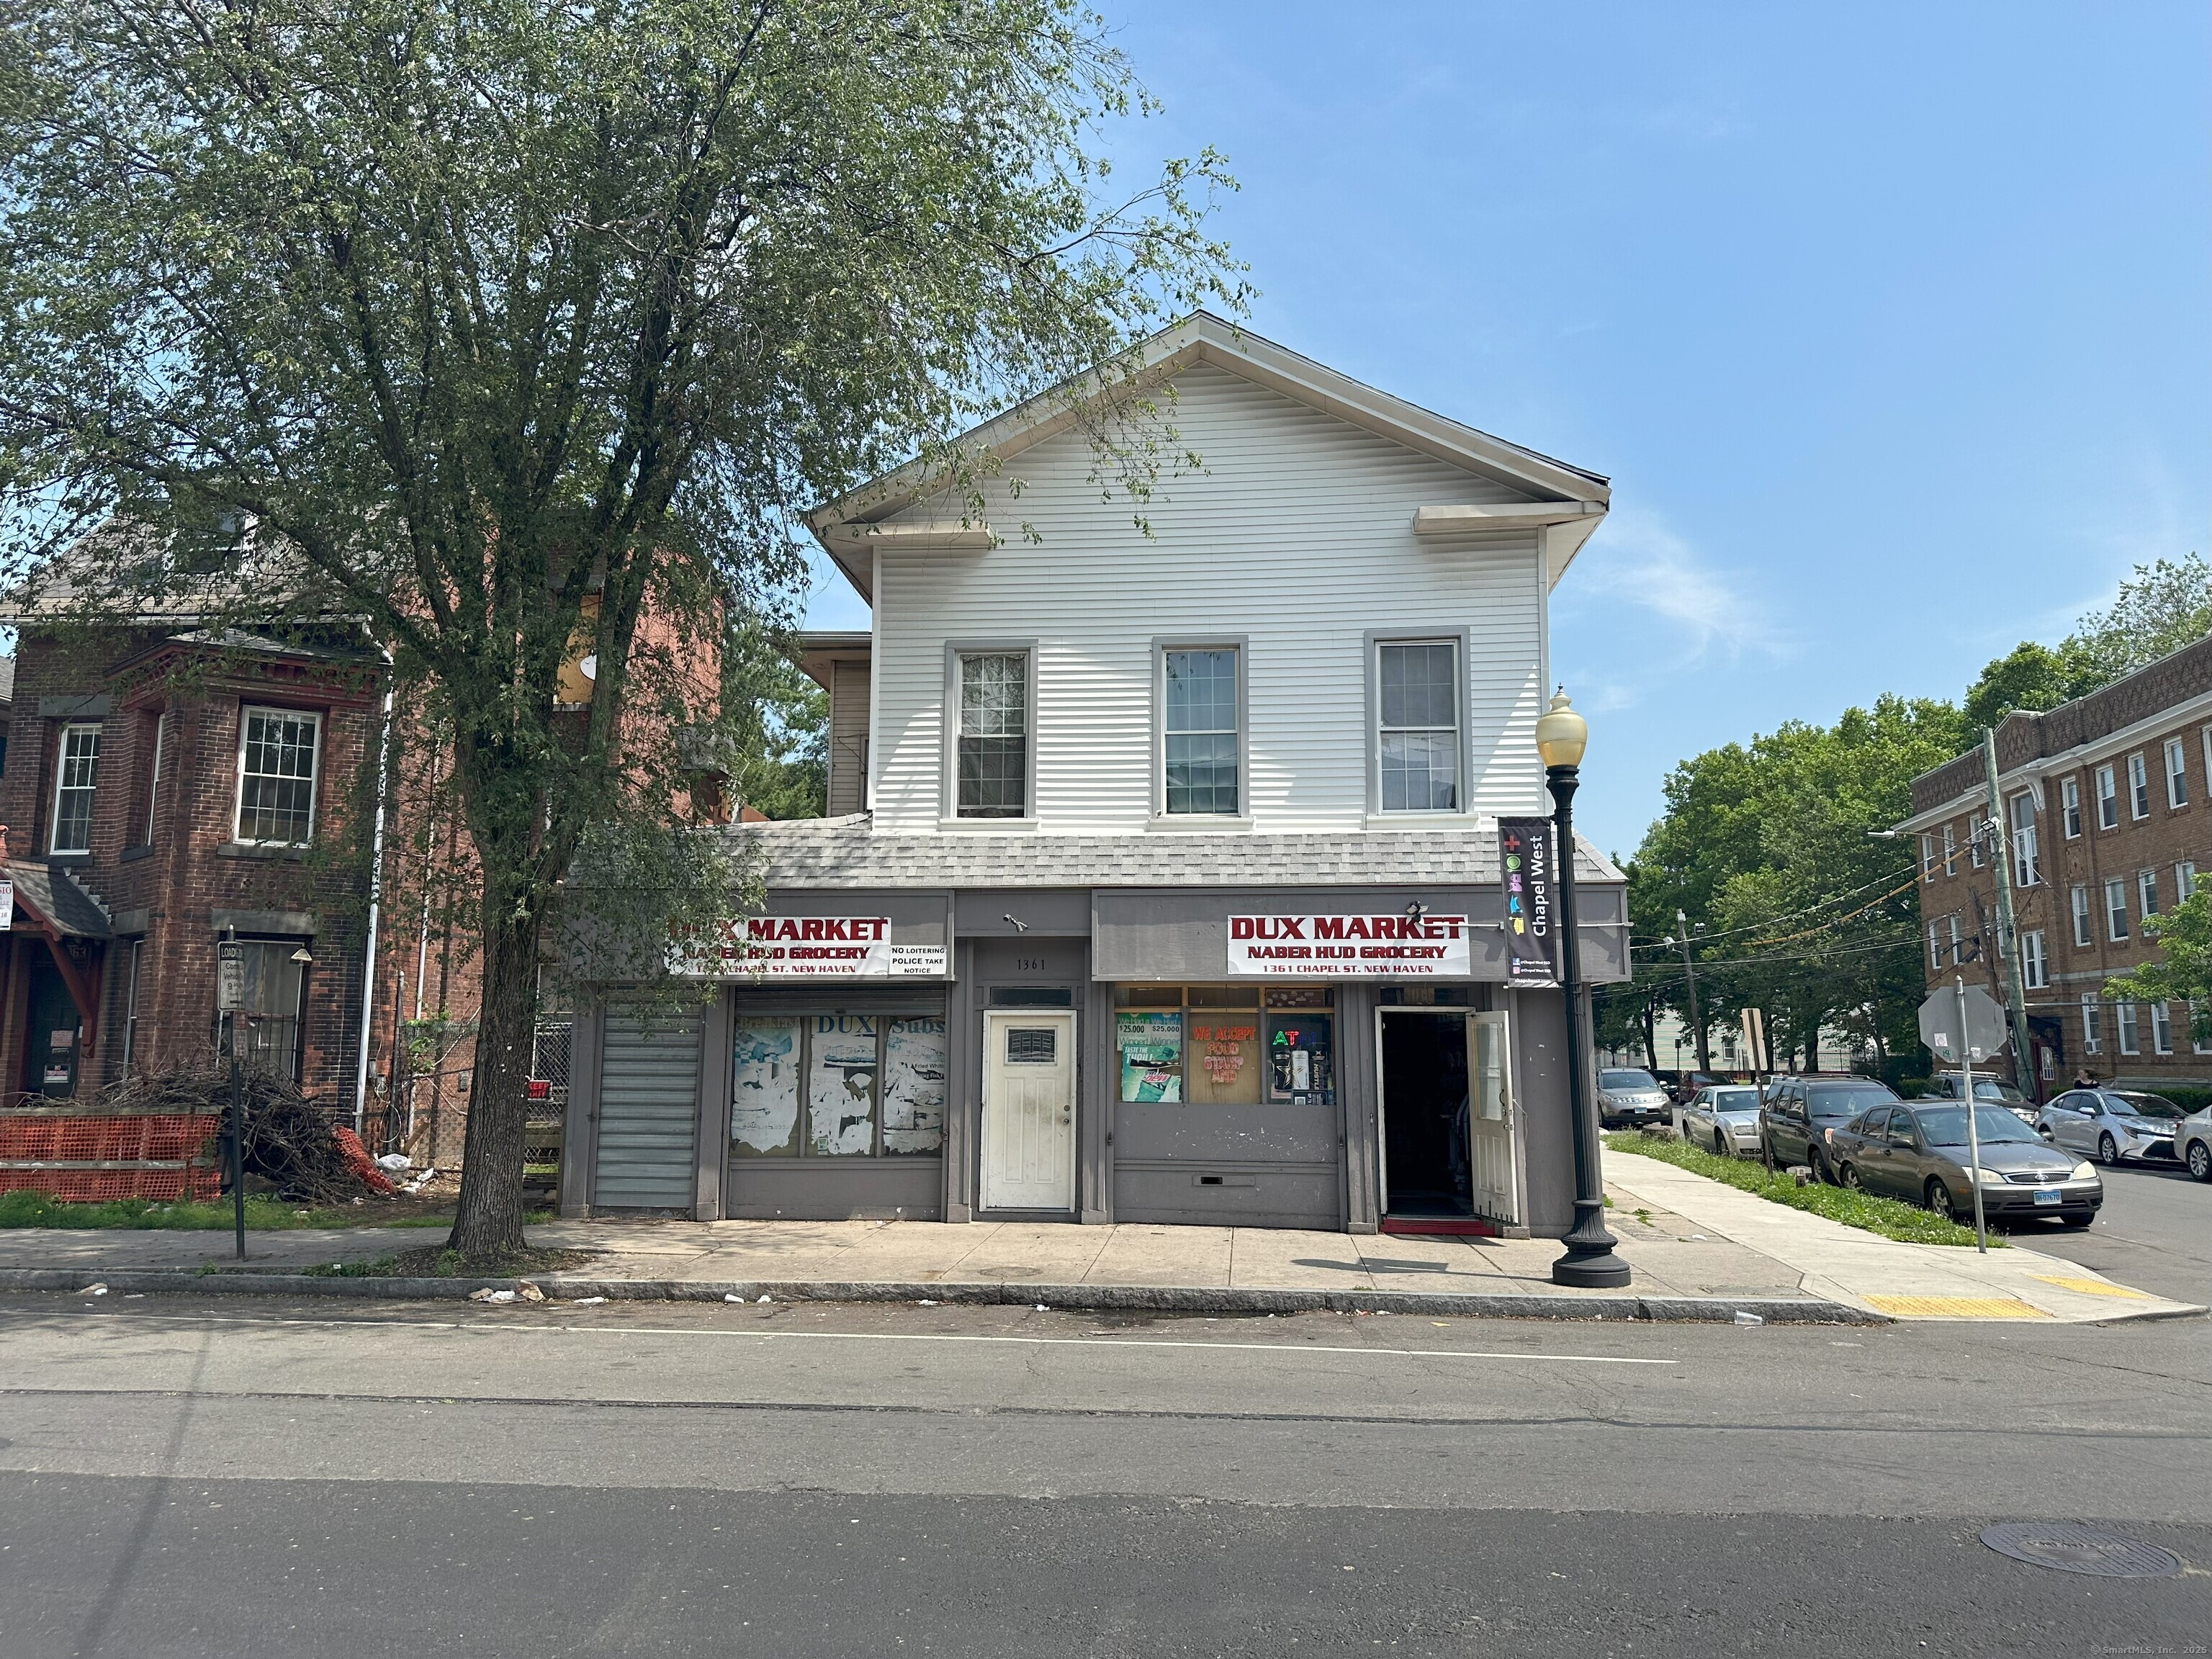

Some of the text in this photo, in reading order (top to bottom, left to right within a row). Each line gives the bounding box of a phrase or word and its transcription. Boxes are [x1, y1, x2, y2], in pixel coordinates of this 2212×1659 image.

[1530, 835, 1550, 936] Chapel West
[748, 919, 889, 940] MARKET
[1231, 917, 1465, 940] DUX MARKET
[788, 946, 871, 959] GROCERY
[1247, 945, 1449, 958] NABER HUD GROCERY
[1017, 958, 1045, 971] 1361
[740, 1017, 800, 1029] Breakfast
[818, 1015, 875, 1033] DUX
[1193, 1026, 1256, 1040] WE ACCEPT
[1272, 1030, 1316, 1046] ATM
[1207, 1042, 1239, 1056] FOOD
[1203, 1056, 1244, 1070] STAMP
[1211, 1069, 1238, 1083] AND
